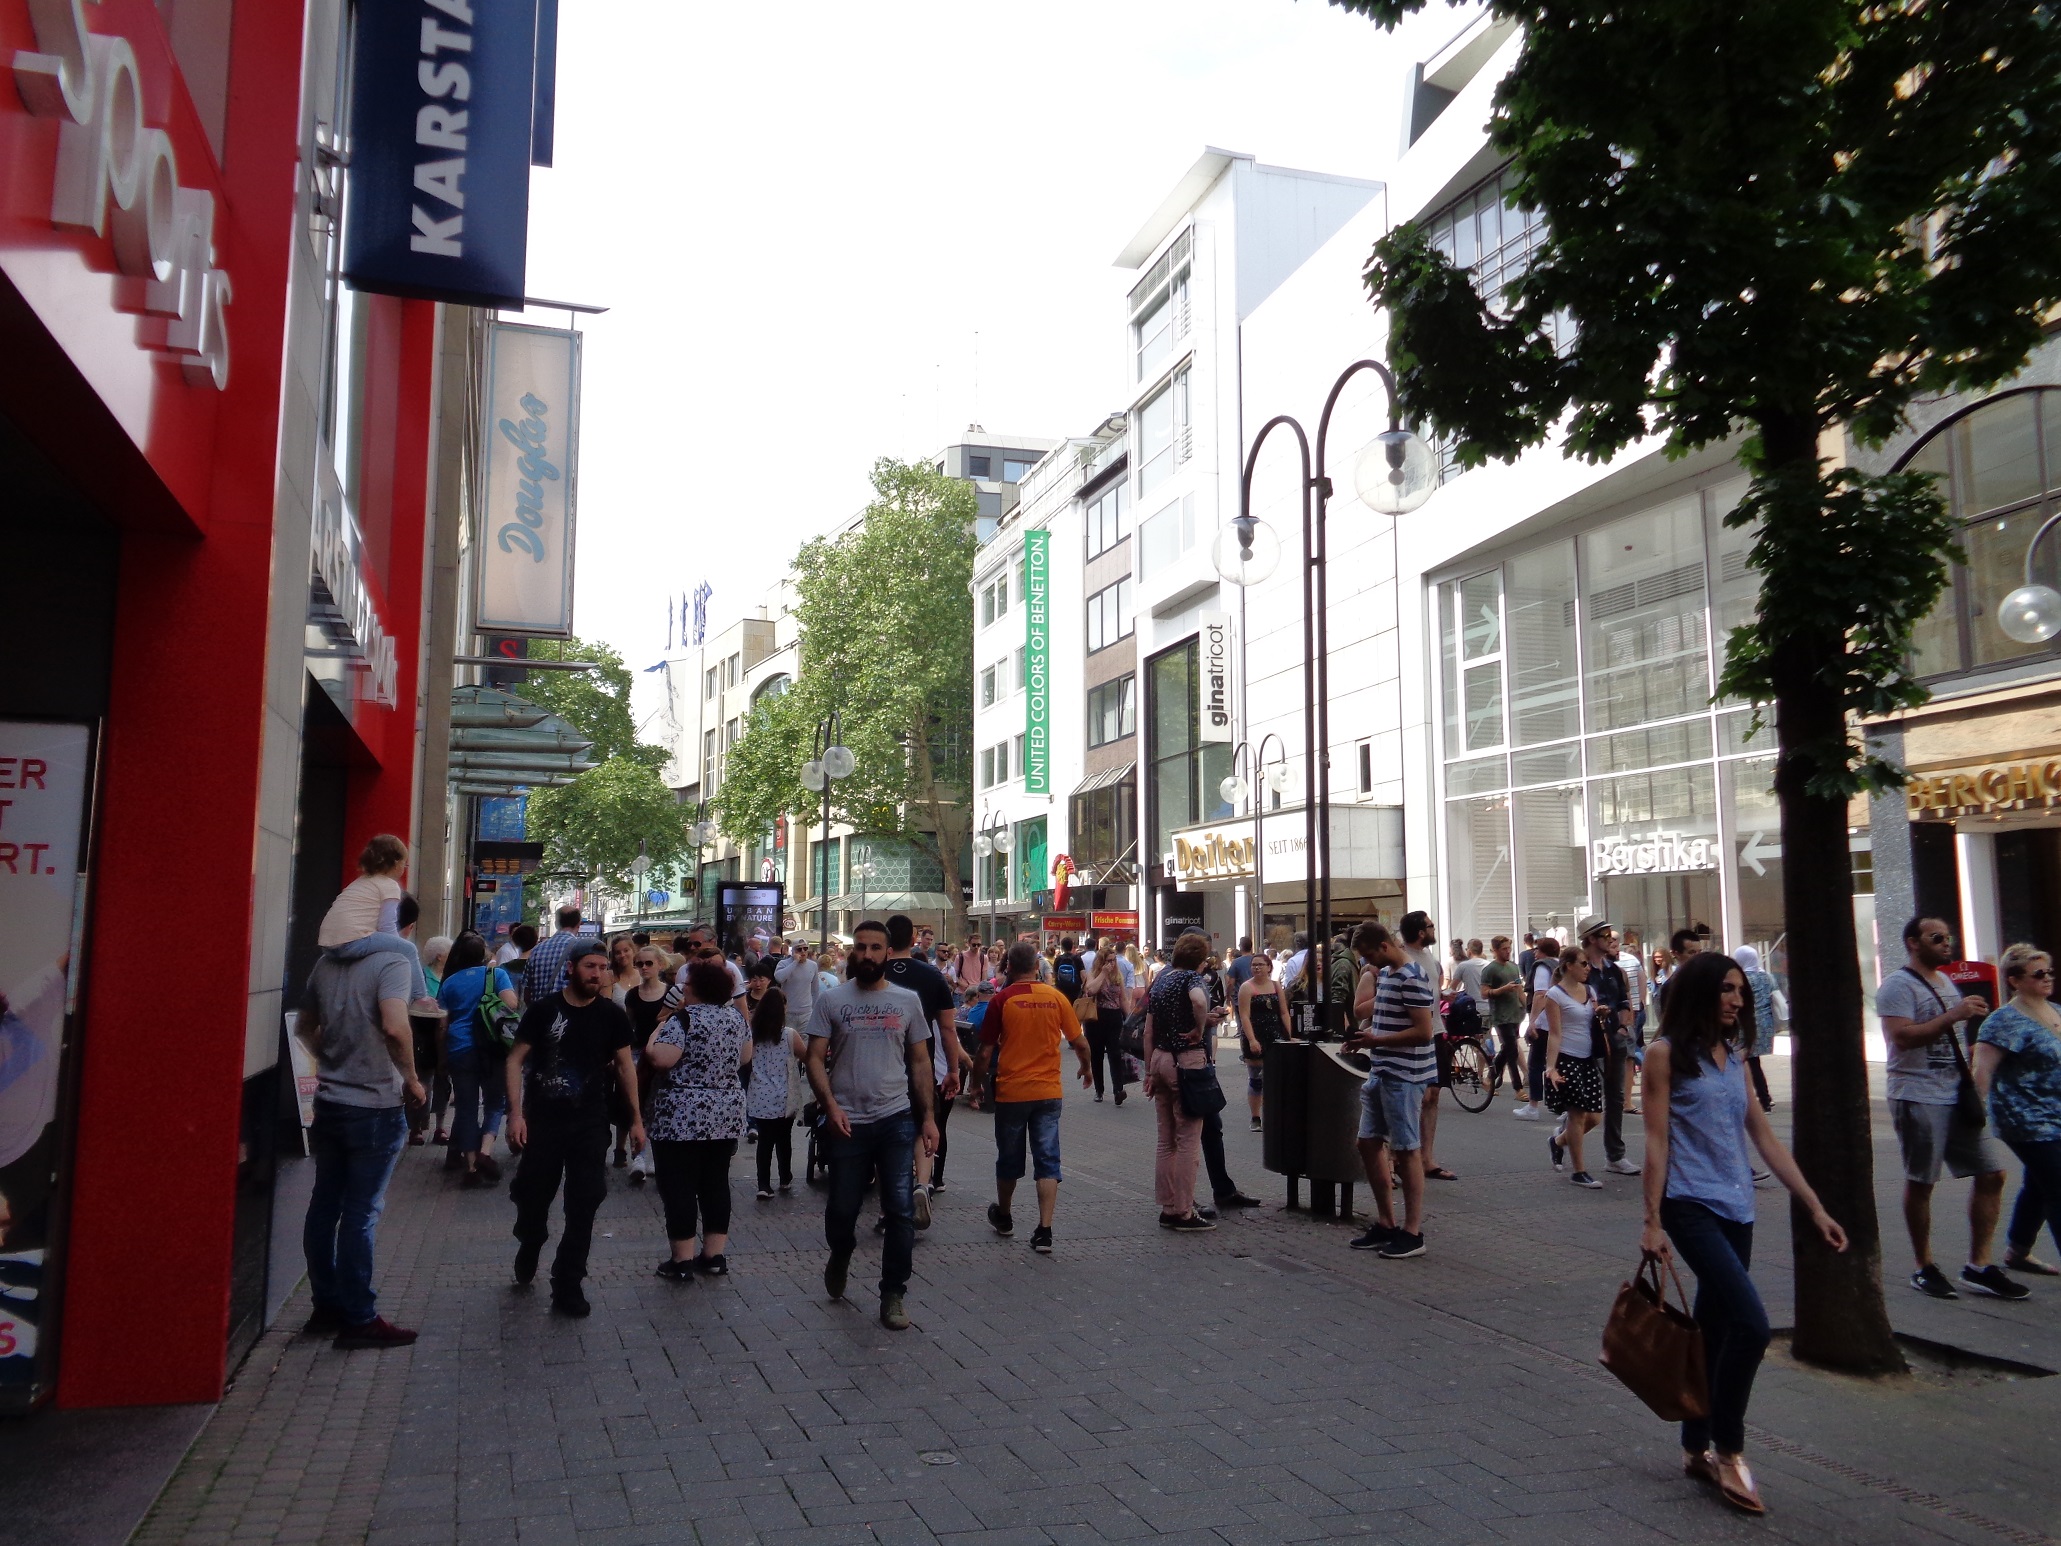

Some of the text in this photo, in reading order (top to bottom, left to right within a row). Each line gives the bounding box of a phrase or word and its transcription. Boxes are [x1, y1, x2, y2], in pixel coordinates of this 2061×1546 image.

[498, 392, 560, 563] Douglas
[1031, 535, 1044, 789] UNITED COLORS OF BENETTON.
[1206, 624, 1229, 727] ginatricot
[1175, 833, 1254, 872] Deiter
[1268, 840, 1287, 855] SEIT
[1593, 833, 1712, 873] Bershka
[1094, 916, 1114, 924] Frische
[1950, 971, 1980, 980] OMEGA
[841, 1003, 880, 1026] Rick's
